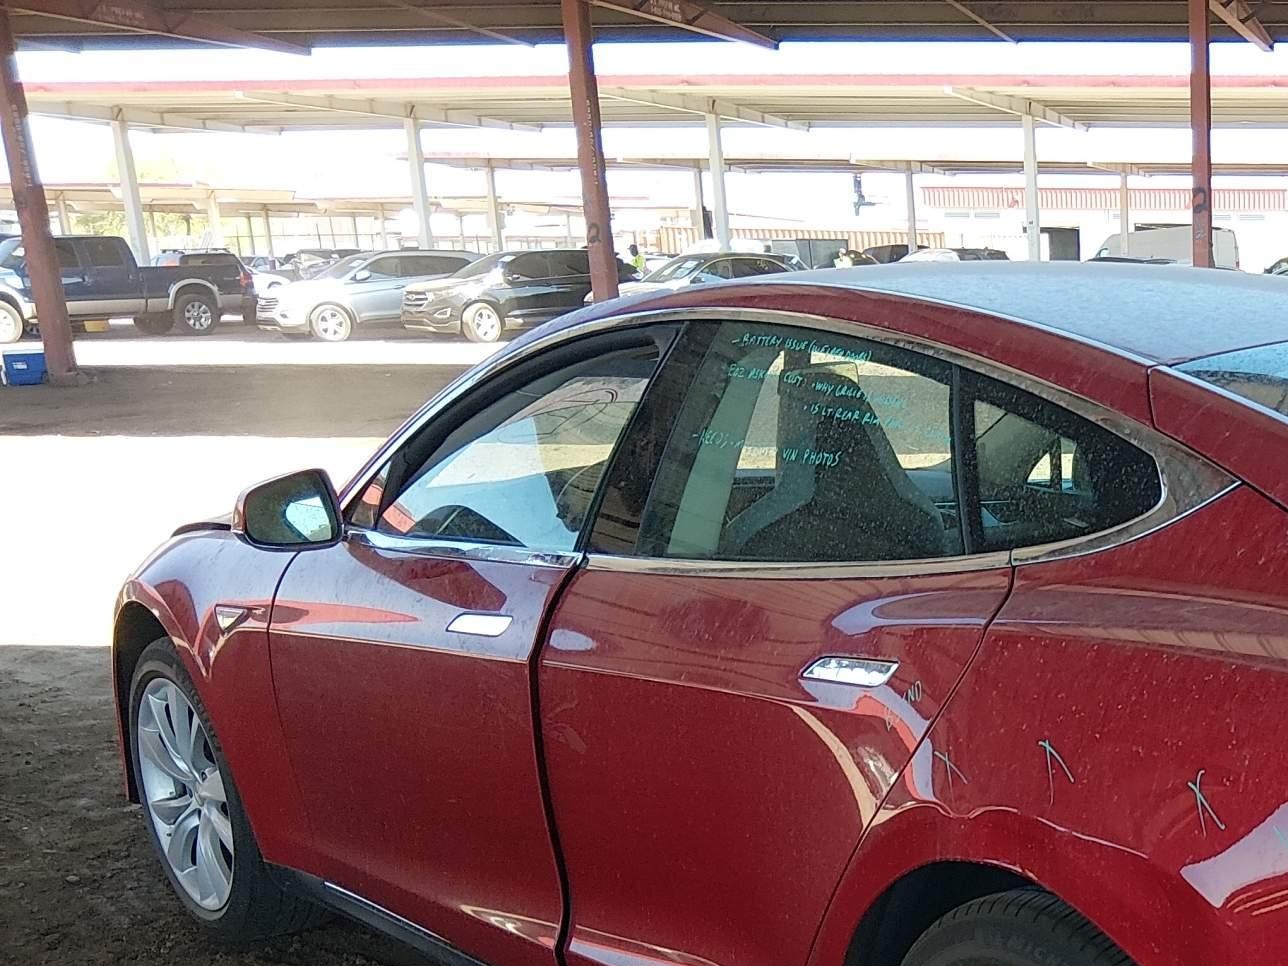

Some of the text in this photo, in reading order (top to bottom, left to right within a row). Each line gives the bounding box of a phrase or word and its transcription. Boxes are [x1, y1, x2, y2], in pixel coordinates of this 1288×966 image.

[741, 333, 782, 347] BATTERY
[785, 338, 808, 350] ISSUE
[803, 449, 843, 467] PHOTOS
